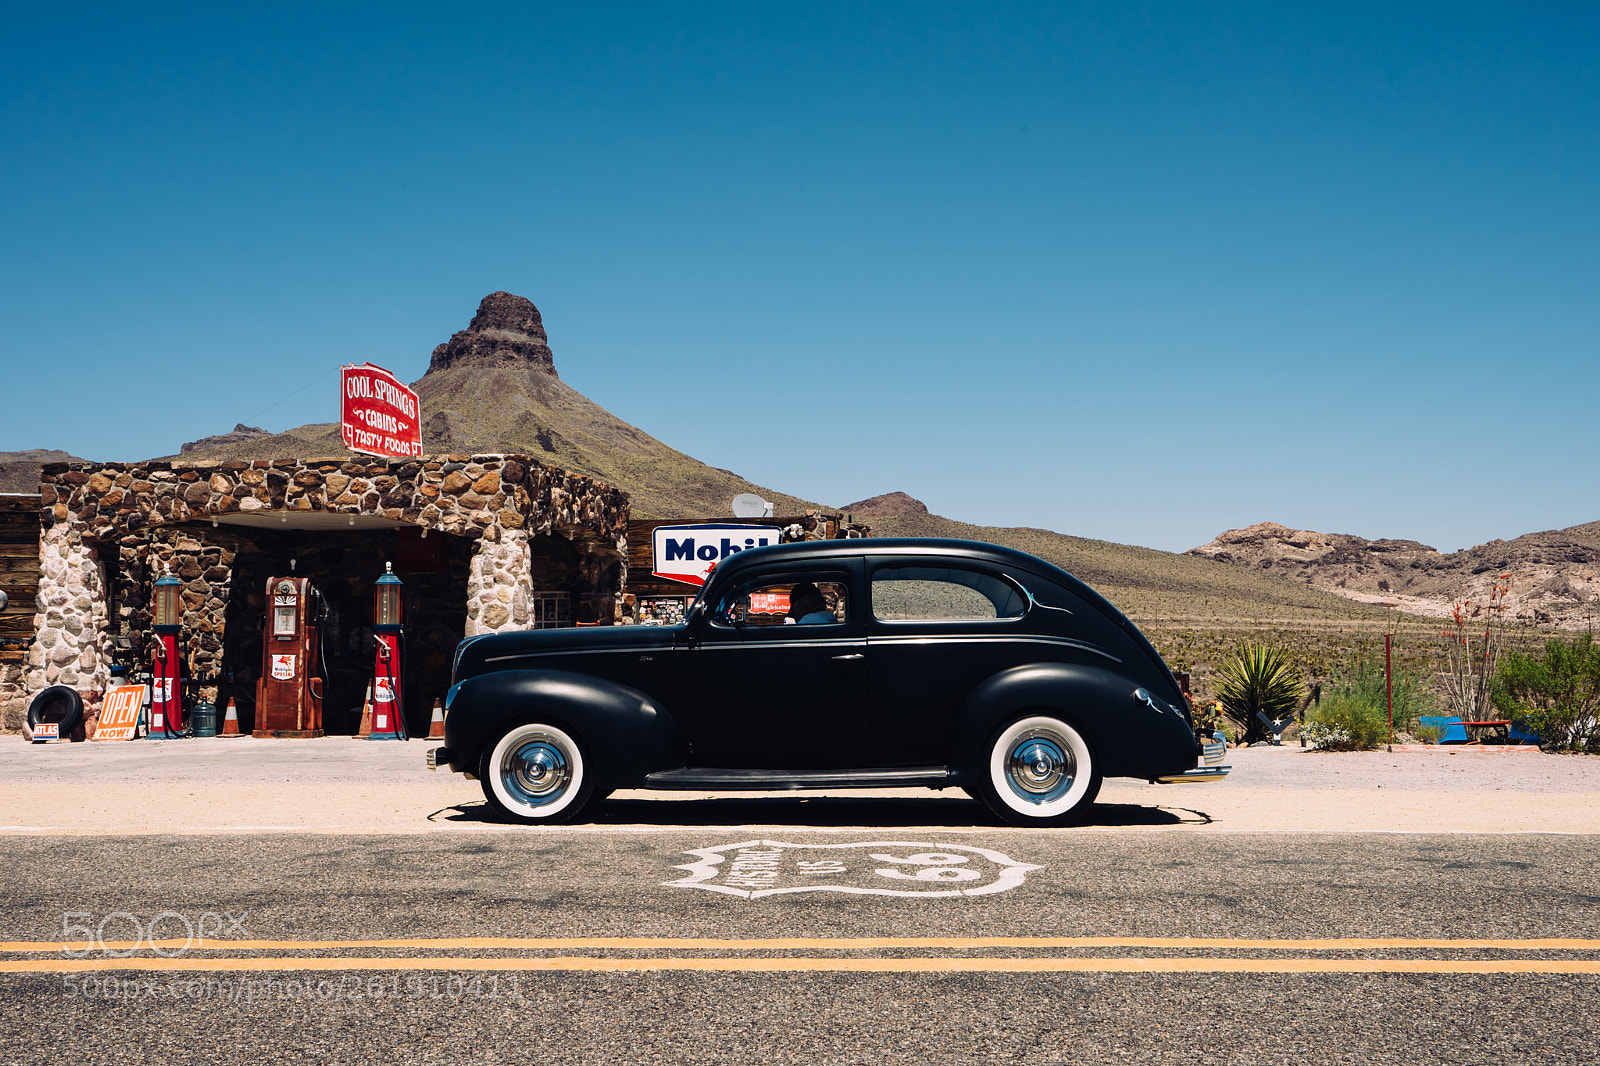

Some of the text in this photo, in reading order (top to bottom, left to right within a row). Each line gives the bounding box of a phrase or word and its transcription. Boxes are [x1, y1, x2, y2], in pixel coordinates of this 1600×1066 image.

[347, 376, 415, 419] COOL SPRINGS
[365, 409, 398, 434] CABINS
[355, 429, 410, 455] TASTY FOODS
[102, 691, 141, 725] OPEN
[34, 725, 58, 735] ATLAS
[99, 728, 130, 738] NOW!
[724, 848, 783, 888] HISTORIC
[797, 860, 848, 874] US
[869, 852, 981, 882] 66
